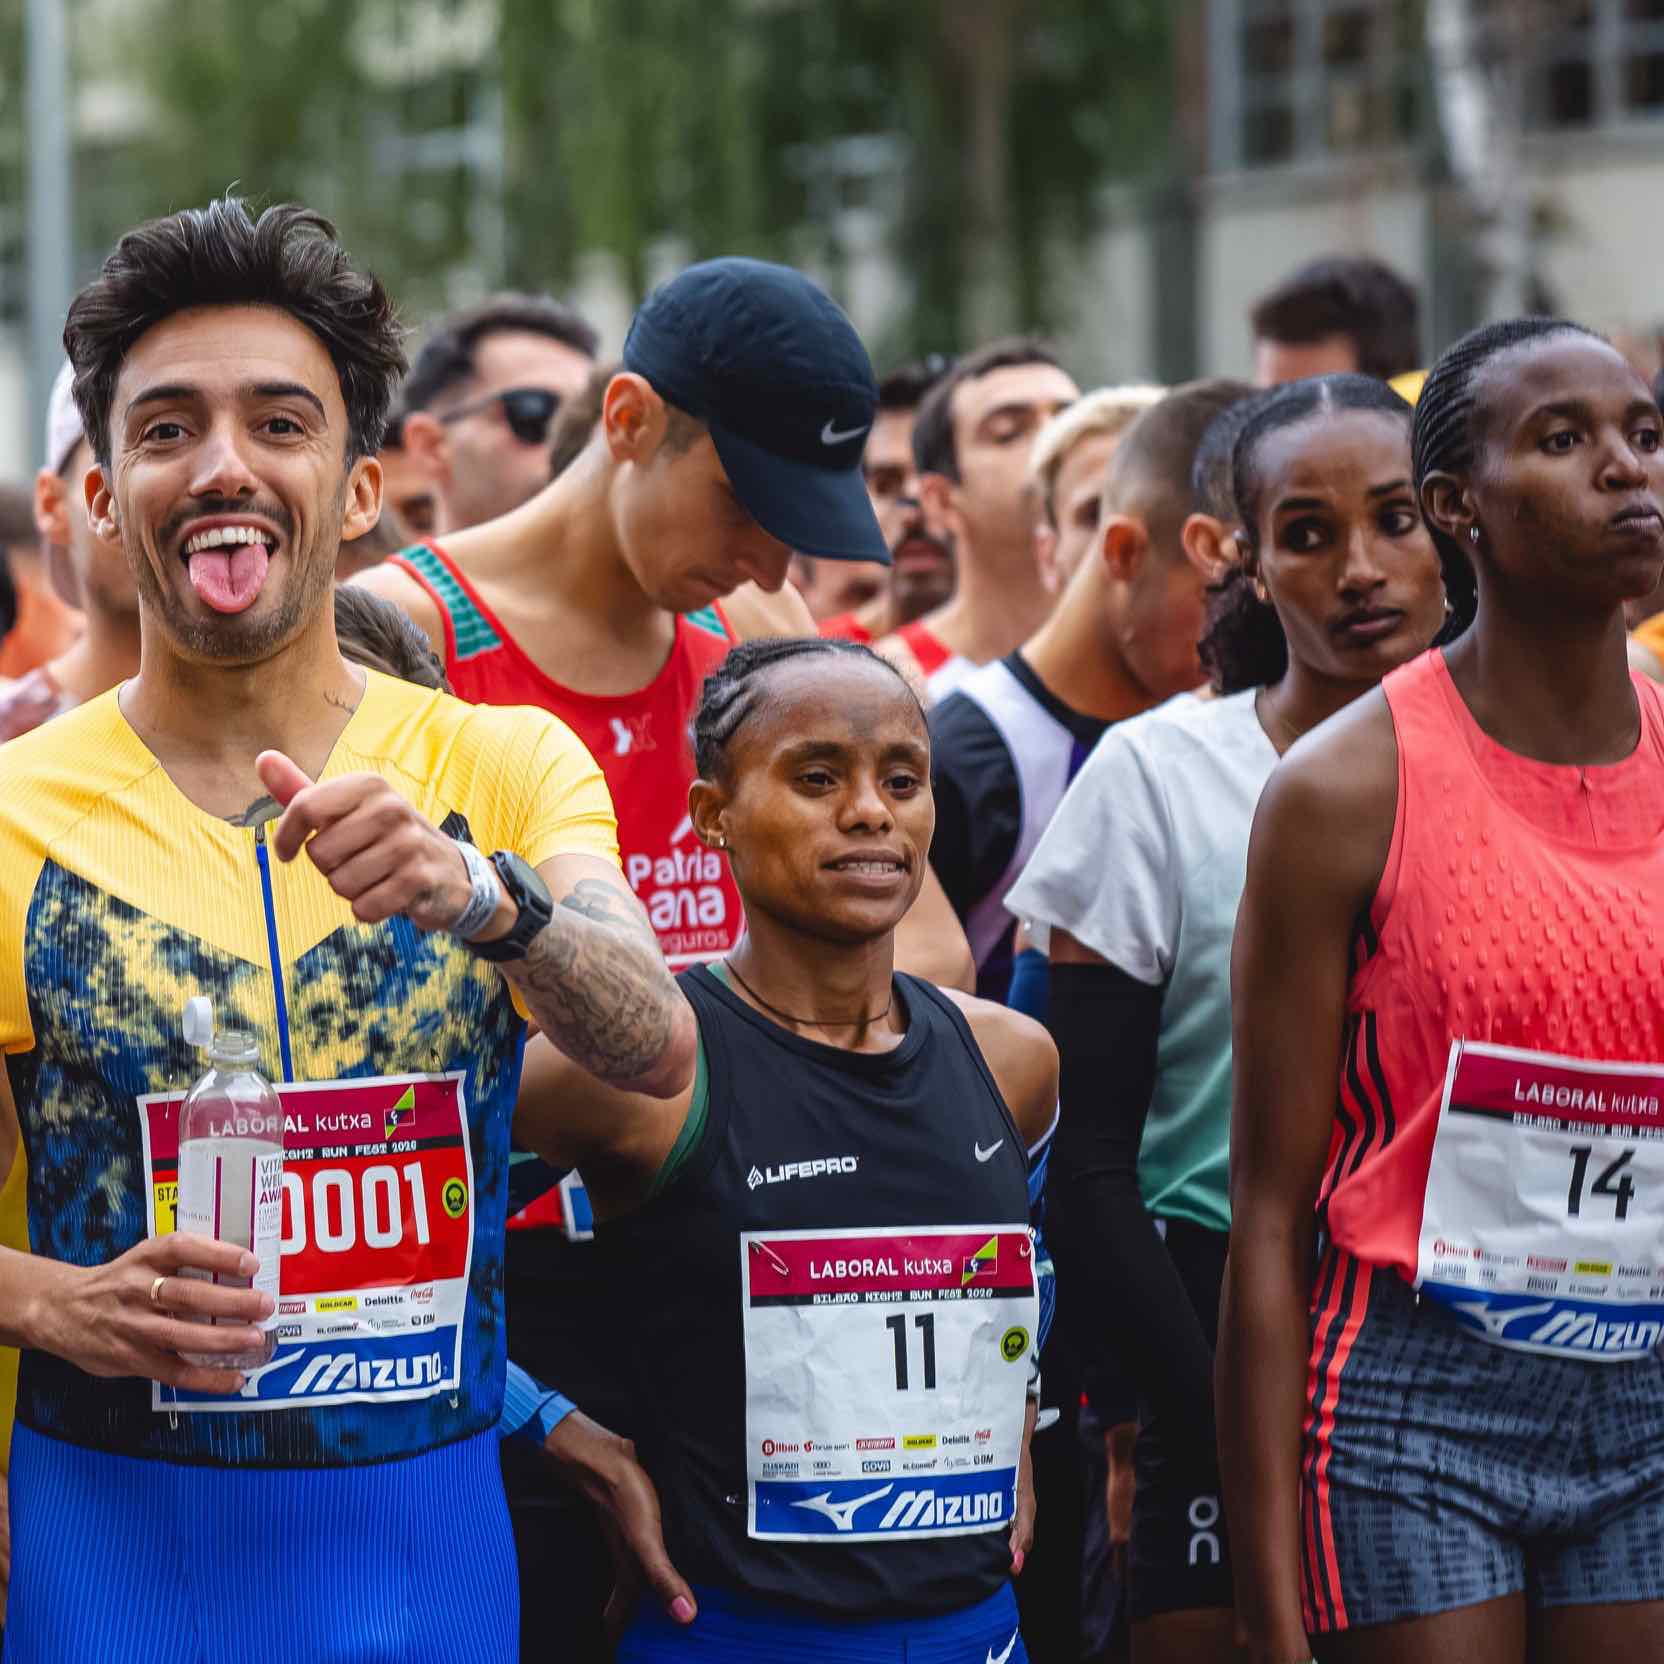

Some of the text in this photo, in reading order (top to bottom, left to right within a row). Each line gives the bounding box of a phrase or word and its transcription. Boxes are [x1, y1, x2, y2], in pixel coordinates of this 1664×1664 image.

[627, 846, 722, 891] Patria
[1514, 1077, 1659, 1116] LABORAL kutxa
[315, 1112, 372, 1133] kutxa
[321, 1145, 348, 1159] RUN
[764, 1155, 859, 1185] LIFEPRO
[1567, 1144, 1636, 1221] 14
[157, 1186, 179, 1202] STA
[279, 1160, 431, 1256] 0001
[809, 1256, 952, 1280] LABORAL kutxa
[909, 1289, 932, 1301] RUN
[883, 1310, 937, 1393] 11
